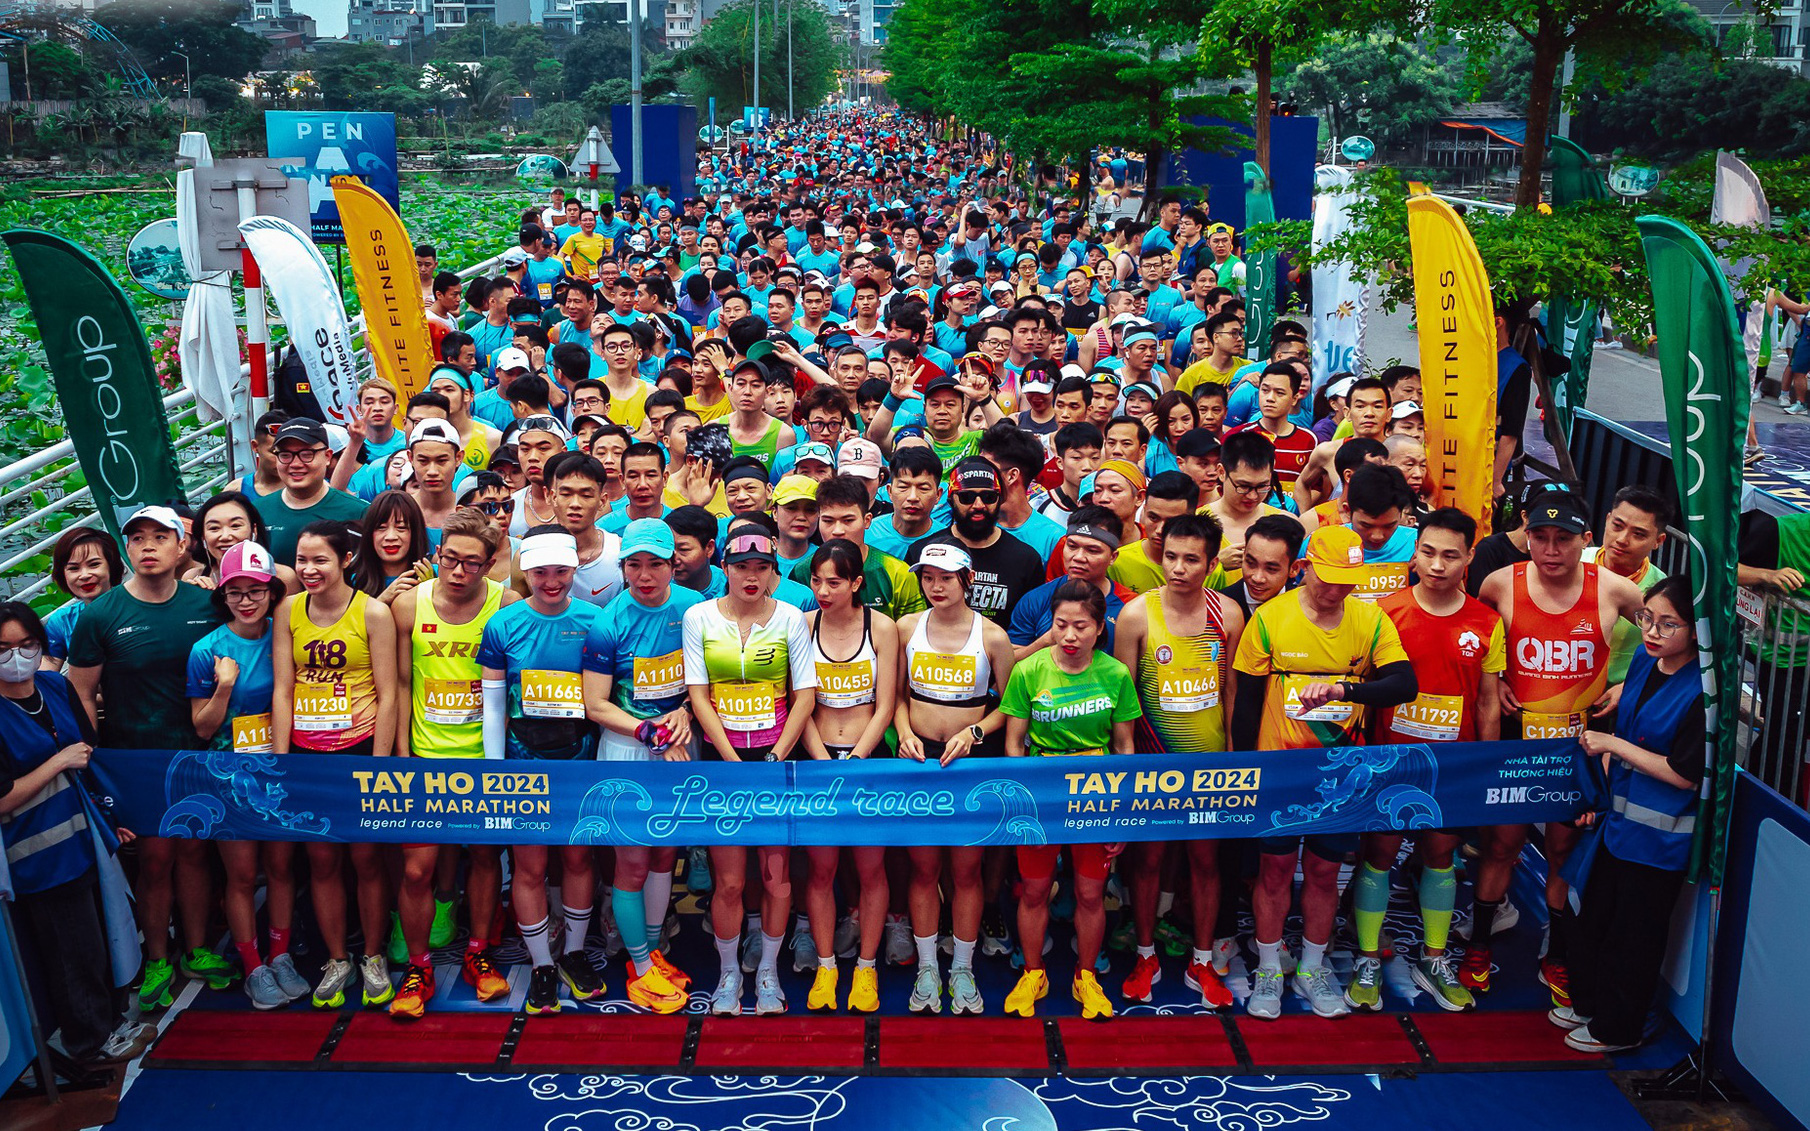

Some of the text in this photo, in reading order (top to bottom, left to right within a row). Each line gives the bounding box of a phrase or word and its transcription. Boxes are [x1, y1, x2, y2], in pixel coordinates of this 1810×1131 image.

[297, 123, 363, 140] PEN
[370, 229, 418, 401] ELITE FITNESS
[1440, 269, 1459, 420] FITNESS
[853, 448, 863, 460] B
[962, 470, 995, 480] SPARTAN
[1516, 637, 1595, 673] QBR
[305, 669, 345, 683] RUN
[815, 673, 871, 690] A10455
[914, 664, 973, 684] A10568
[524, 684, 582, 700] A11665
[1161, 675, 1216, 694] A10466
[295, 697, 348, 713] A11230
[427, 691, 483, 707] A10733
[719, 696, 772, 713] A10132
[1397, 704, 1460, 724] A11792
[1526, 723, 1585, 739] C12397
[1547, 766, 1573, 777] HIỆU
[352, 771, 546, 795] TAY HO 2024
[1065, 770, 1256, 795] TAY HO 2024
[1067, 794, 1258, 813] HALF MARATHON
[1485, 785, 1582, 805] BIMGroup
[361, 798, 550, 814] HALF MARATHON
[647, 775, 955, 838] Legend race
[360, 817, 407, 830] legend
[411, 820, 443, 829] race
[484, 817, 551, 832] BIMGroup
[1064, 817, 1110, 829] legend
[1115, 817, 1147, 826] race
[1189, 810, 1255, 824] BIMGroup
